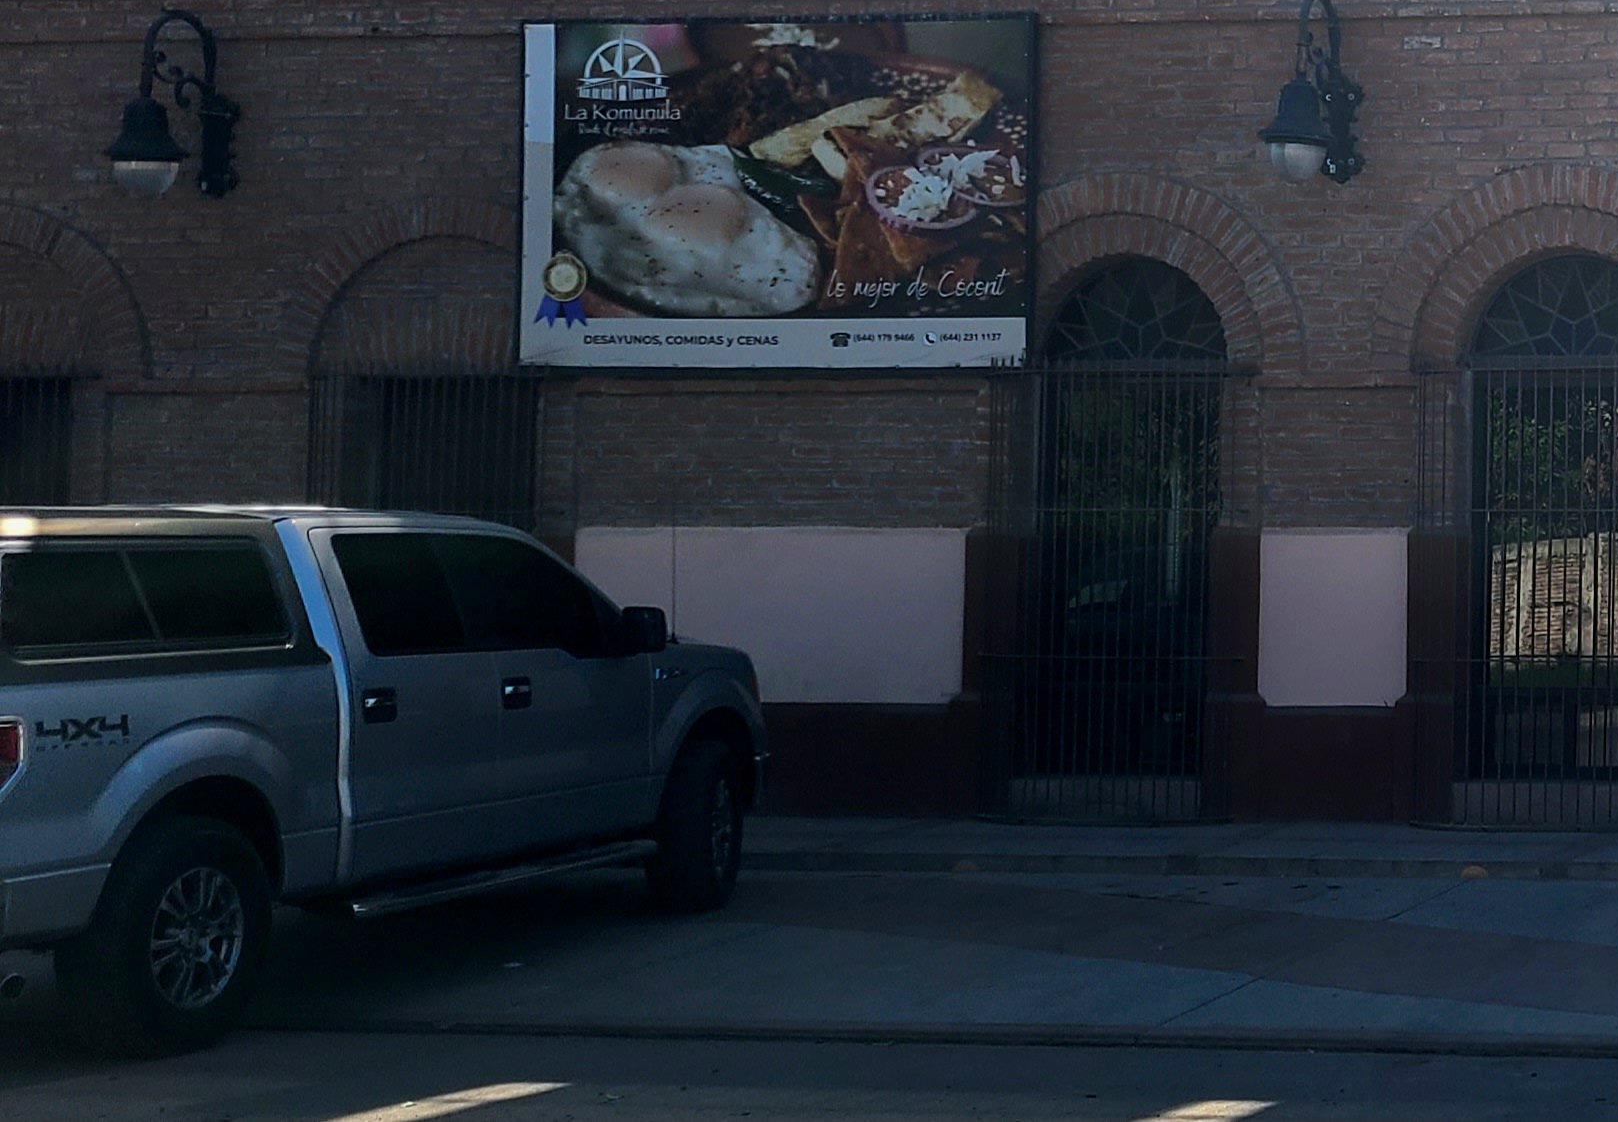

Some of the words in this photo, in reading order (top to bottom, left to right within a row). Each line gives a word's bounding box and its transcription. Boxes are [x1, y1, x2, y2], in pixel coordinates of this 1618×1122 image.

[564, 103, 588, 120] La
[853, 277, 901, 308] mejor
[907, 265, 930, 301] de
[583, 334, 662, 346] DESAYUNOS,
[665, 335, 724, 346] COMIDAS
[726, 337, 733, 348] y
[737, 335, 779, 346] CENAS
[853, 332, 875, 343] (644)
[940, 332, 961, 343] (644)
[963, 332, 978, 342] 231
[982, 332, 1001, 342] 1137
